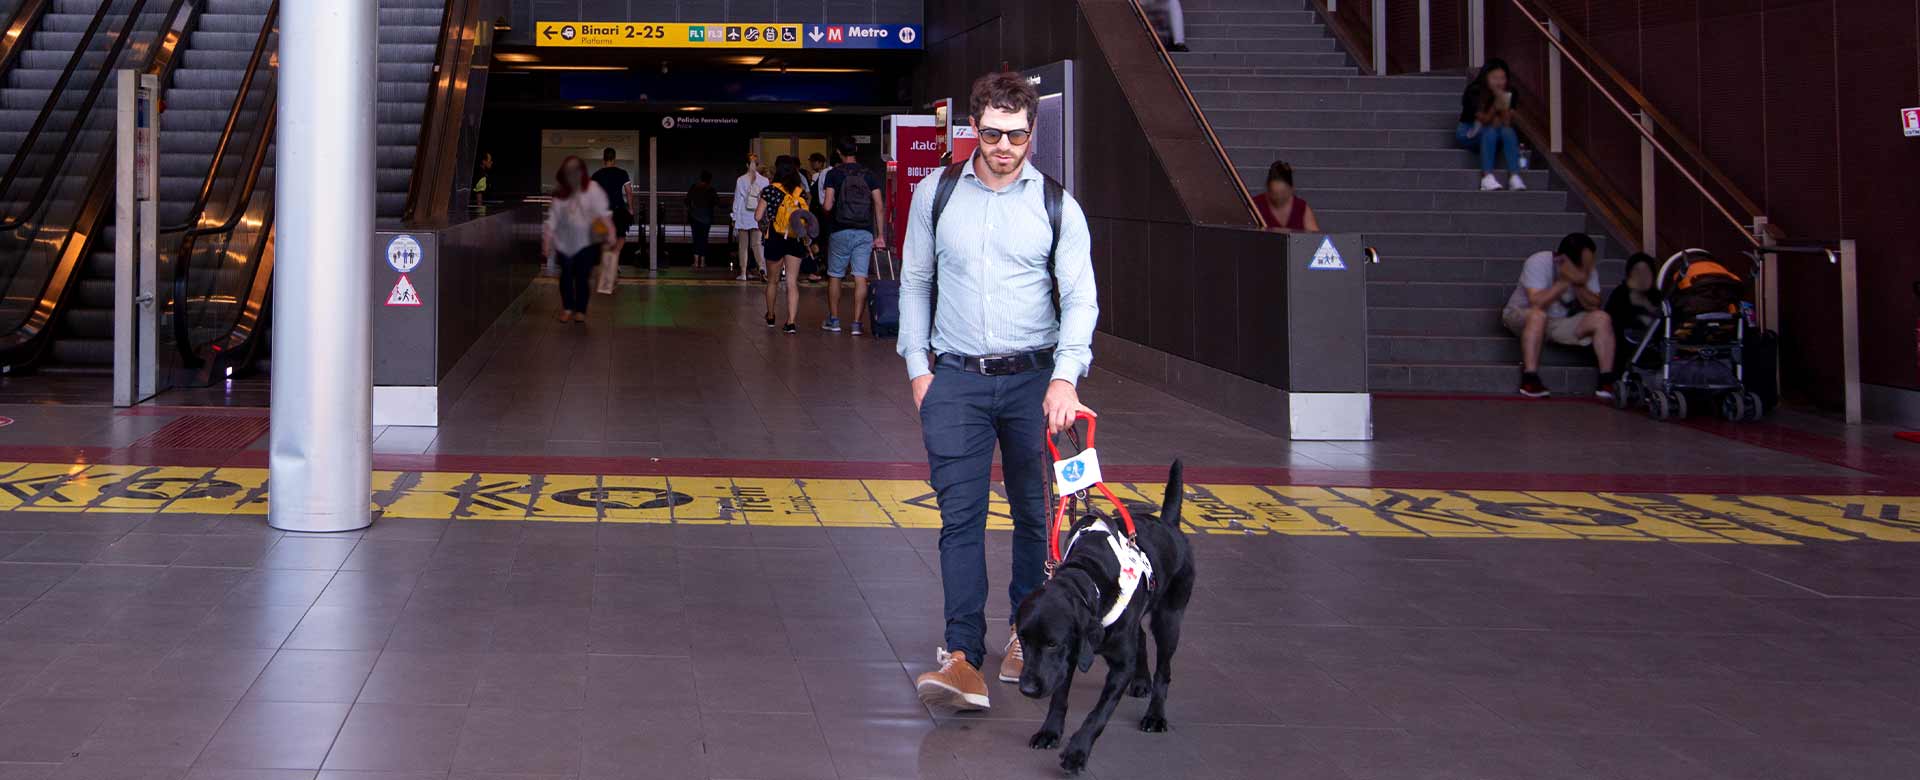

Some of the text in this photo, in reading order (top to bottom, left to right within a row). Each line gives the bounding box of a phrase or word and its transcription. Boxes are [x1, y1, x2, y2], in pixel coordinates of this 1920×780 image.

[581, 25, 665, 39] Binari 2-25
[689, 28, 704, 38] FL1
[828, 26, 888, 41] M Metro
